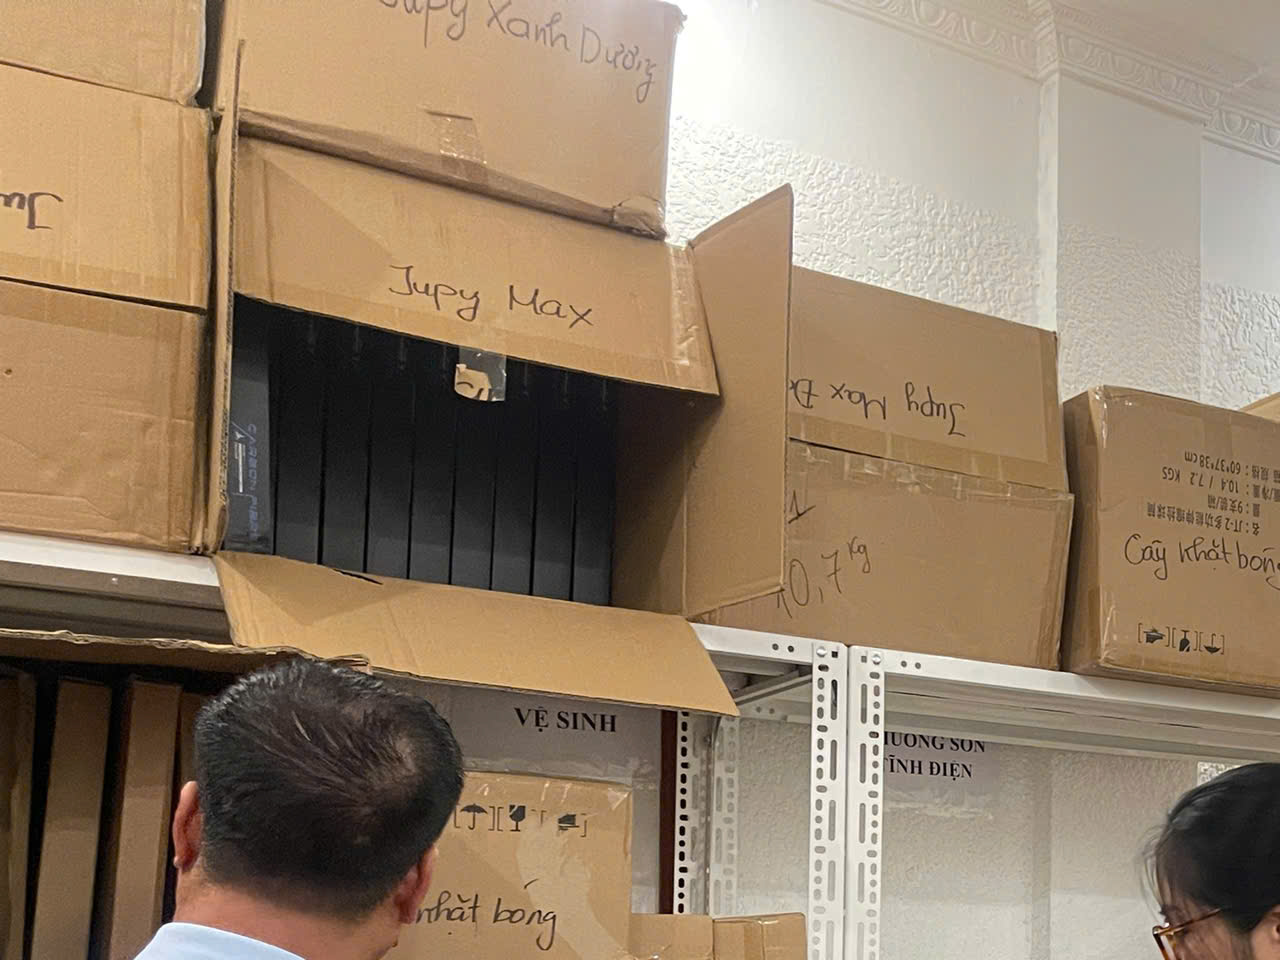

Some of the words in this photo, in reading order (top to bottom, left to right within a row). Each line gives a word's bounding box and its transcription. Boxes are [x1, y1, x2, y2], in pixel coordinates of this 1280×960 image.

[388, 265, 481, 322] Jupy
[509, 285, 594, 329] Max
[829, 383, 886, 420] Max
[905, 382, 966, 437] Jupy
[1161, 466, 1181, 483] KGS
[1189, 472, 1204, 487] 7.2
[1220, 478, 1239, 493] 10.4
[514, 706, 548, 732] VỆ
[557, 711, 616, 732] SINH
[929, 760, 972, 781] ĐIỆN
[493, 878, 558, 951] bóng
